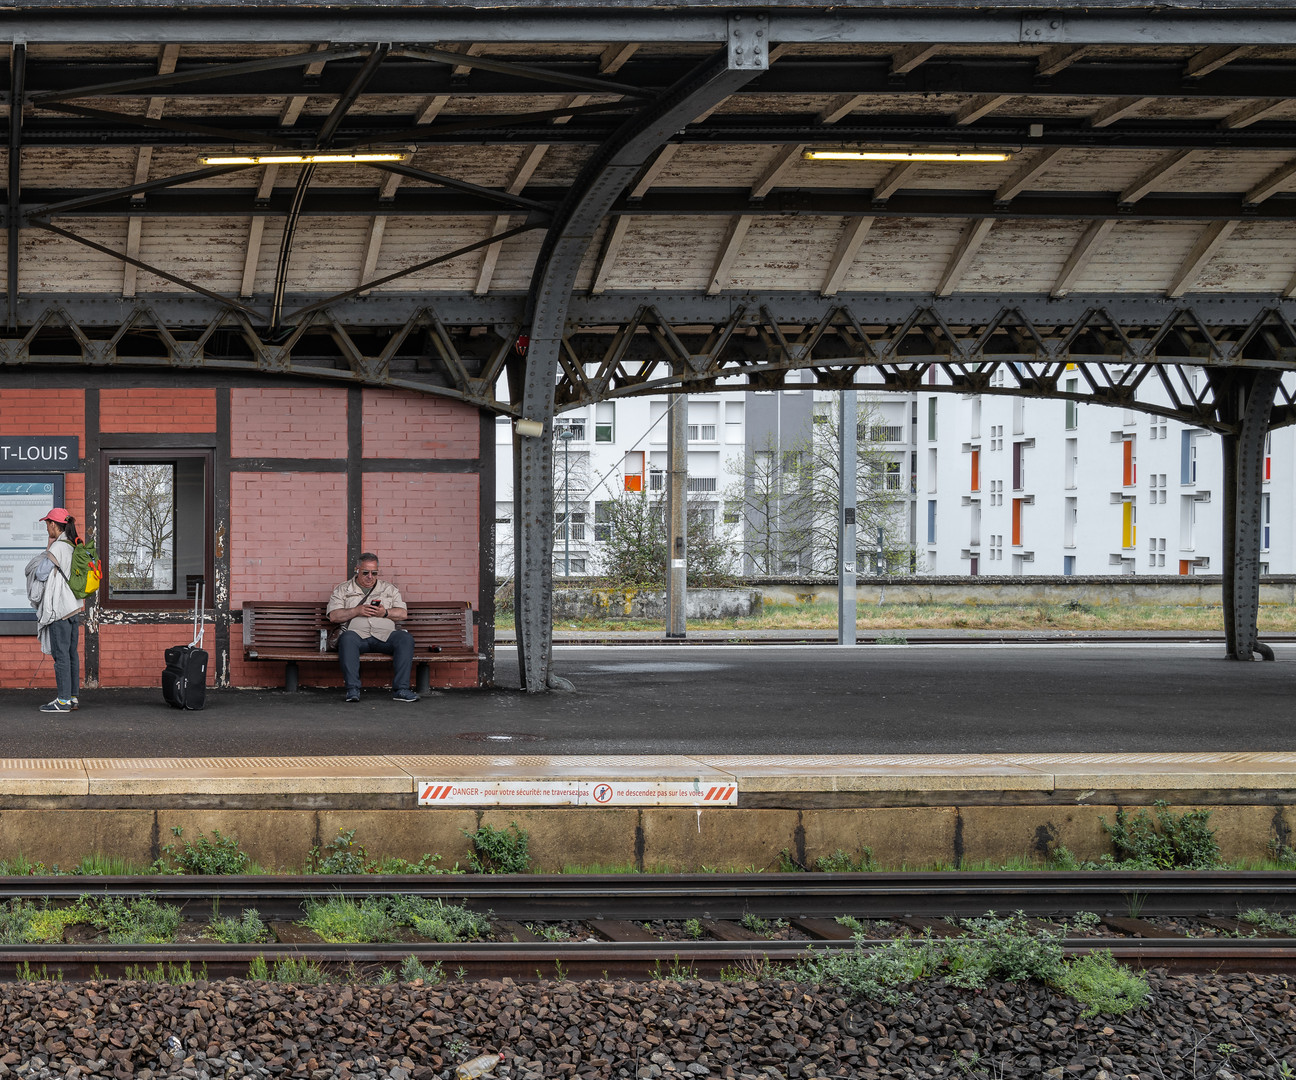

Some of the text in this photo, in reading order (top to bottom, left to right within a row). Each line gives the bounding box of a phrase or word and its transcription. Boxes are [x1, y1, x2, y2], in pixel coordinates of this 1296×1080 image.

[452, 787, 479, 796] DANGER
[484, 790, 498, 798] pour
[552, 788, 578, 796] traversez
[579, 790, 589, 798] pas
[625, 788, 656, 796] descendez
[679, 788, 687, 796] les
